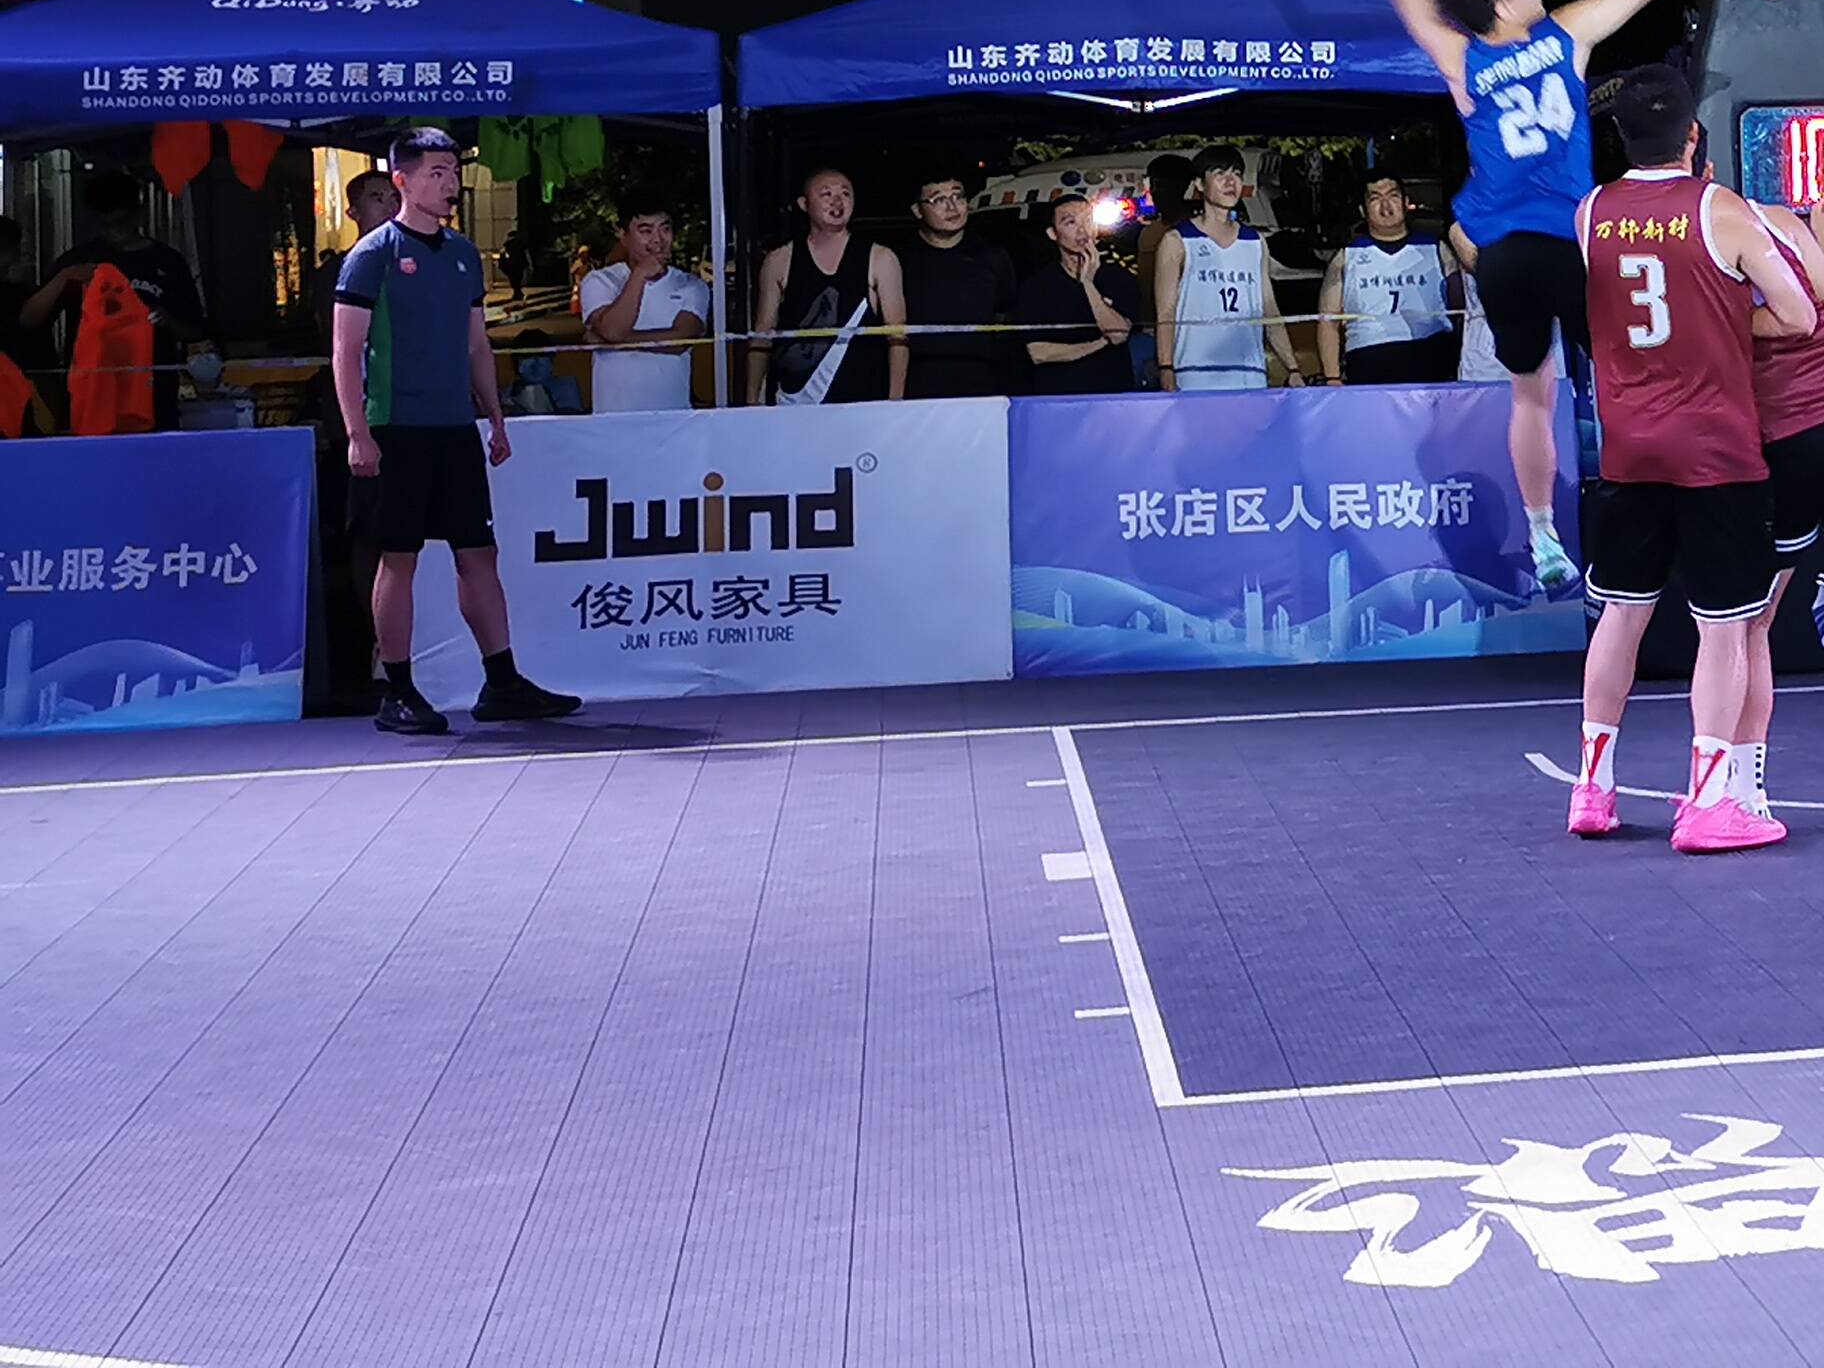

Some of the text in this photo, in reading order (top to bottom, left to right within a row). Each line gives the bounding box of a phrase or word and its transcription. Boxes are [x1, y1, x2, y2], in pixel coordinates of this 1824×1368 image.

[947, 36, 1337, 69] 山东齐动体育发展有限公司
[82, 60, 514, 92] 山东齐动体育发展有限公司
[947, 71, 1033, 86] SHANDONG
[1036, 69, 1095, 83] QIDONG
[1097, 65, 1158, 80] SPORTS
[1158, 65, 1268, 79] DEVELOPMENT
[82, 94, 176, 109] SHANDONG
[179, 93, 246, 109] QIDONG
[248, 91, 315, 106] SPORTS
[317, 90, 437, 104] DEVELOPMENT
[1491, 72, 1577, 160] 24
[1218, 287, 1239, 313] 12
[1388, 290, 1400, 314] 7
[1619, 253, 1671, 349] 3
[534, 466, 854, 563] Jwind
[1117, 478, 1475, 540] 张店区人民政府
[0, 542, 259, 593] 业服务中心
[571, 572, 843, 630] 俊风家具
[619, 625, 795, 651] JUN FENG FURNITURE
